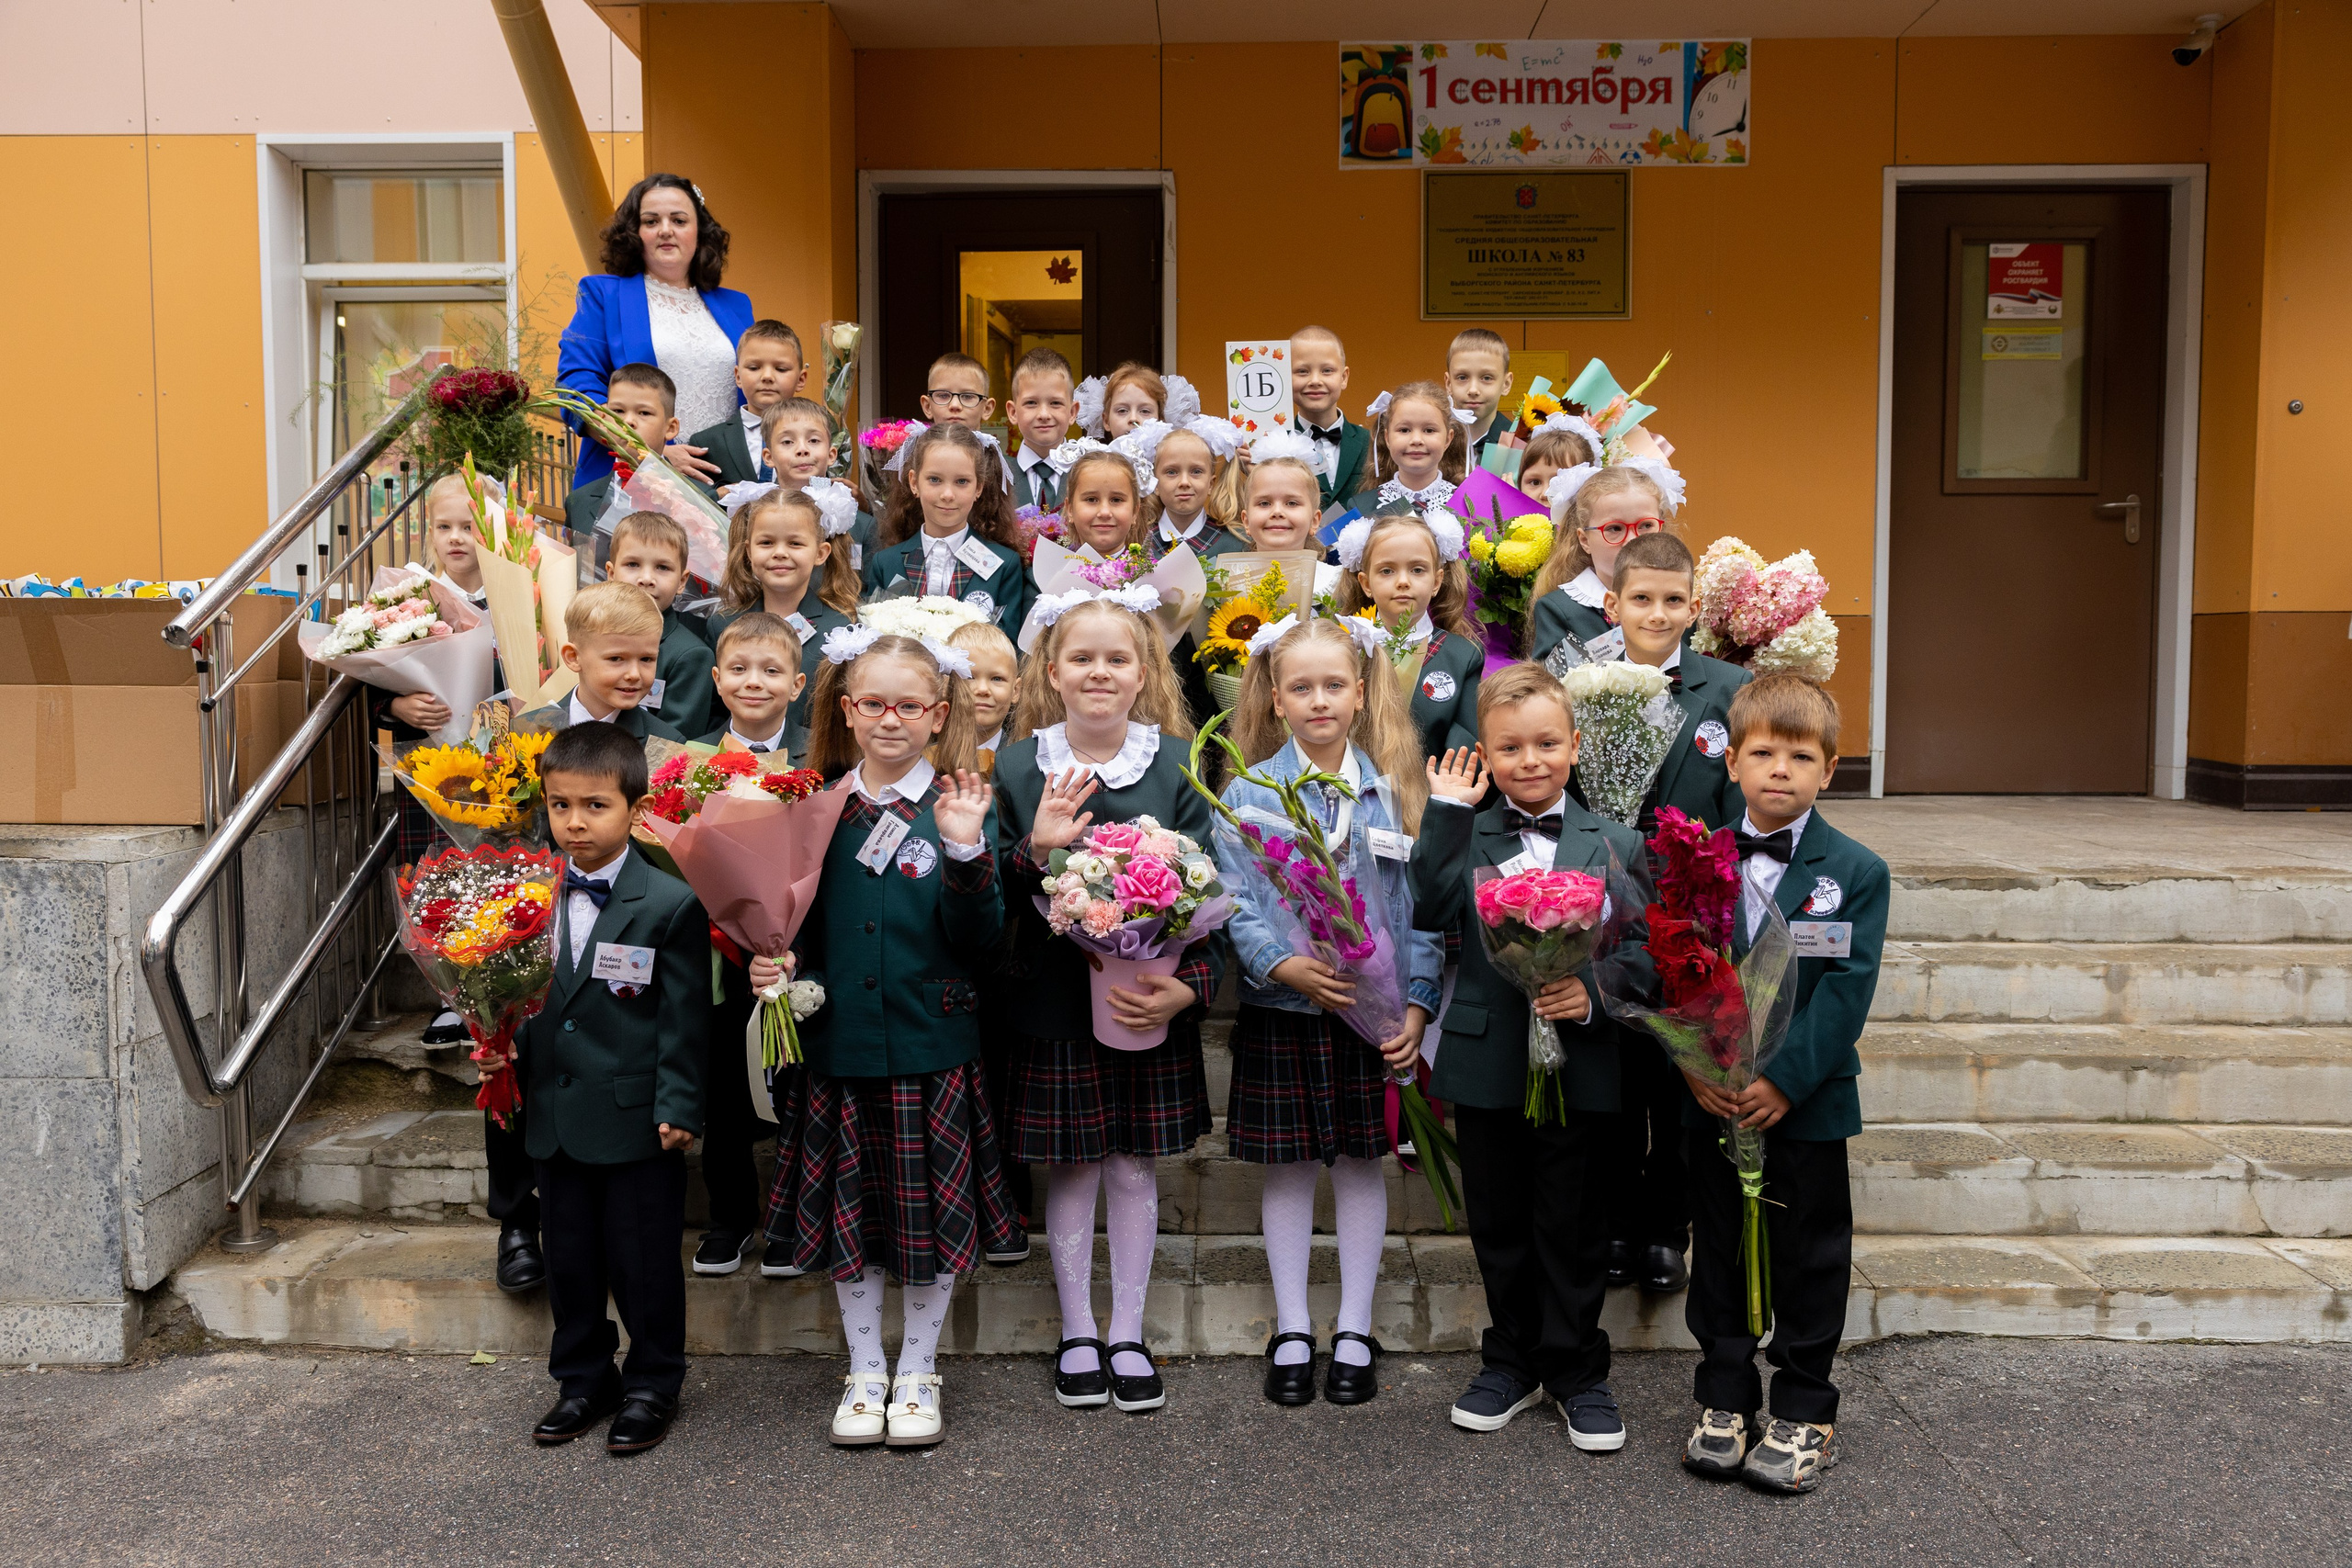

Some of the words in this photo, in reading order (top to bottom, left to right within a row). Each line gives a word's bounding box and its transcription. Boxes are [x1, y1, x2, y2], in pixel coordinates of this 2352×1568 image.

[1419, 63, 1439, 108] 1
[1447, 65, 1673, 115] сентября
[1726, 79, 1736, 90] 11
[1706, 92, 1719, 104] 10
[1697, 109, 1704, 119] 9
[1467, 248, 1542, 263] ШКОЛА
[1547, 250, 1563, 263] №
[1567, 248, 1585, 263] 83
[2002, 276, 2049, 285] РОСГВАРДИЯ
[1242, 372, 1275, 398] 1Б
[599, 954, 622, 964] Абубакр
[598, 962, 621, 970] Аскаров
